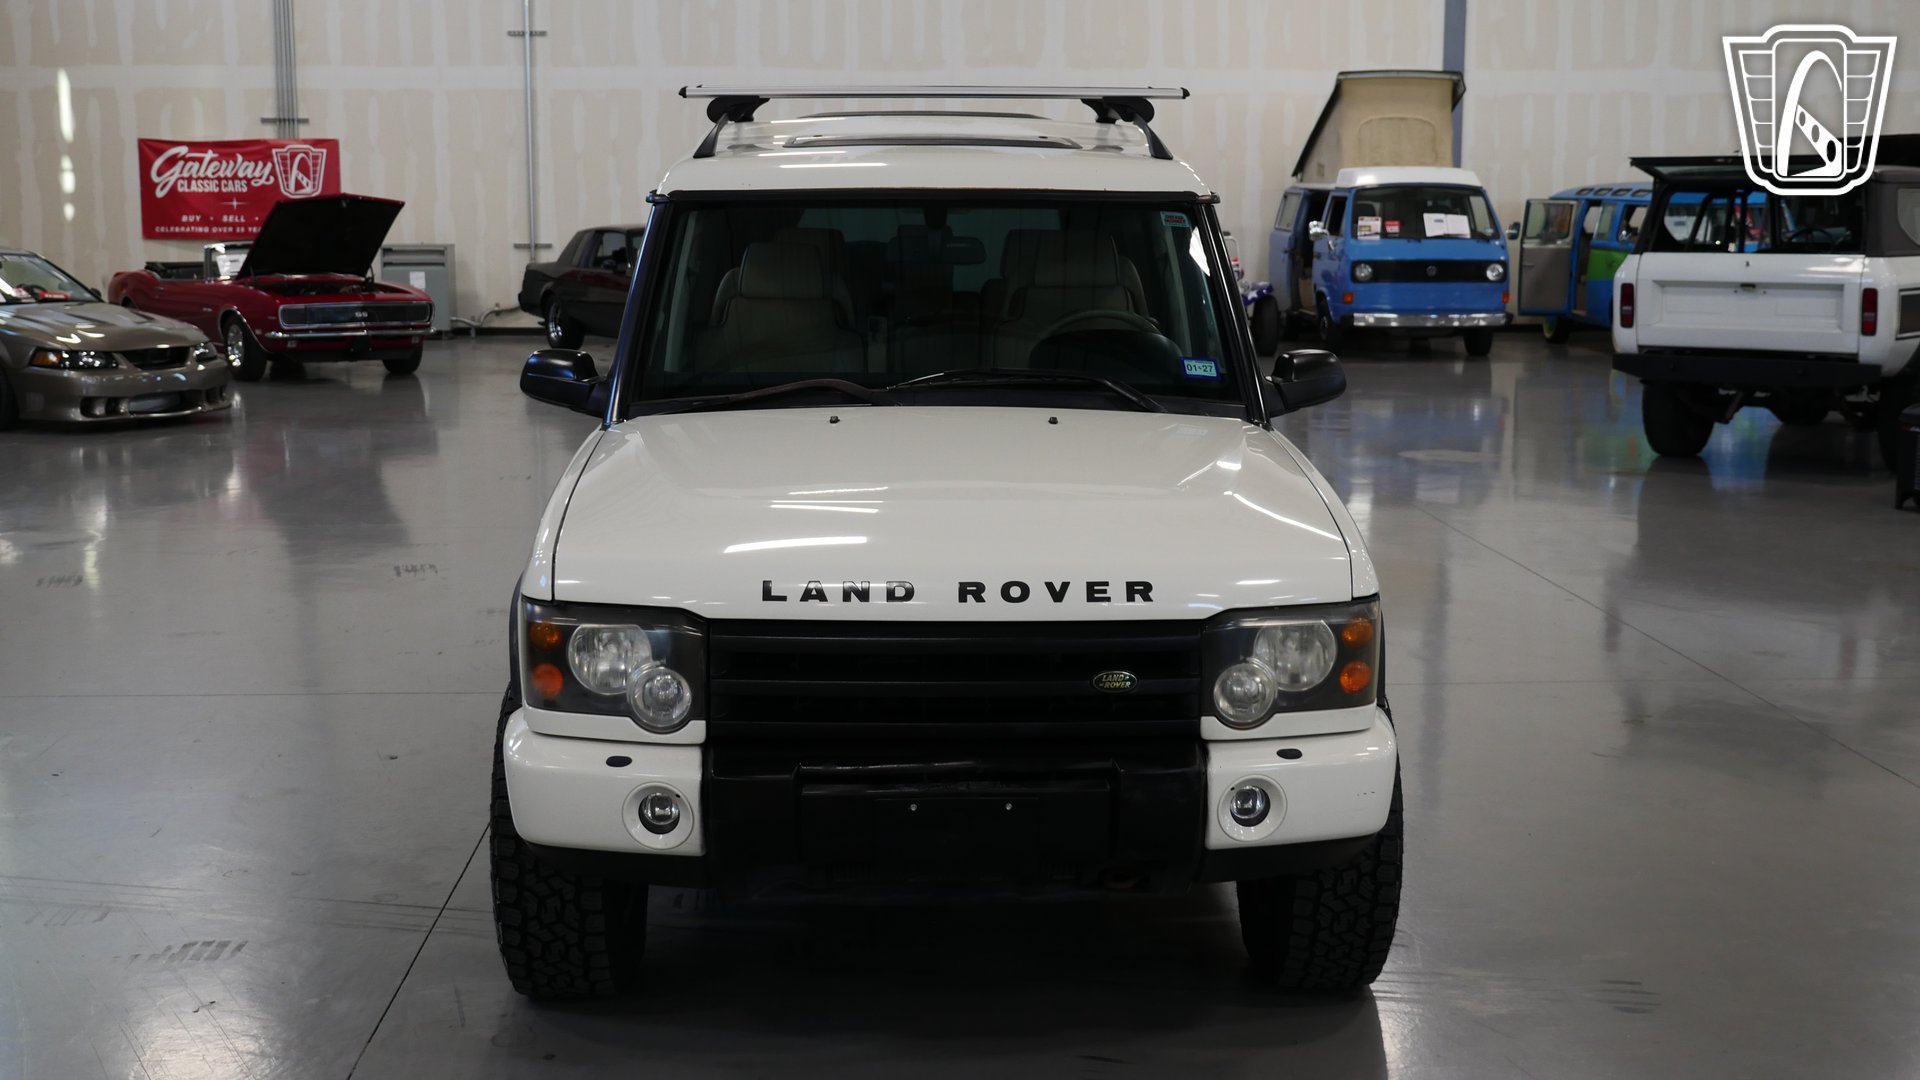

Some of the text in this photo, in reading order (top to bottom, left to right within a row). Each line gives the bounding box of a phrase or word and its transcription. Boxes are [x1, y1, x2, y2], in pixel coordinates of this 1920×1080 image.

[150, 145, 275, 198] Gateway
[177, 179, 248, 193] CLASSIC CARS
[181, 214, 246, 223] BUY SELL
[155, 225, 209, 233] CELEBRATING
[211, 225, 233, 233] OVER
[761, 580, 1154, 603] LAND ROVER
[1102, 674, 1124, 682] LAND
[1104, 681, 1131, 689] ROVER
